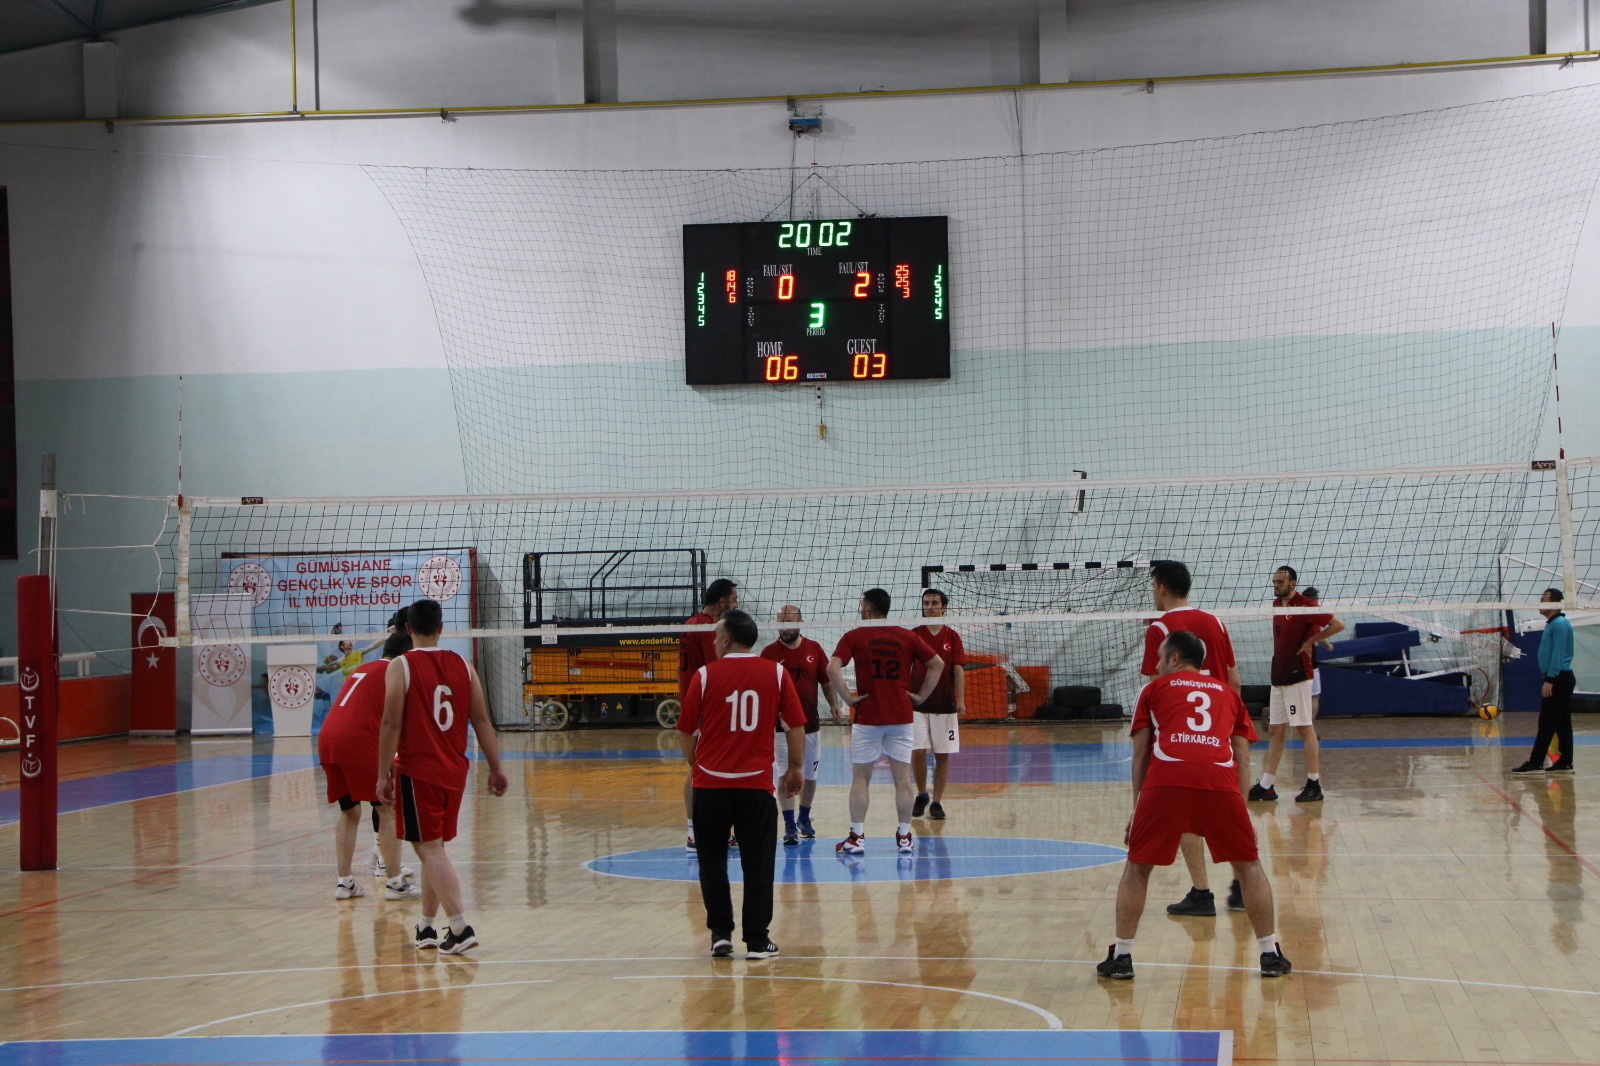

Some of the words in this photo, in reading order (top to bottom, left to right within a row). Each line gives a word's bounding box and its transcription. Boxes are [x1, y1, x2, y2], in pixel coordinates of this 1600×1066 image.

[778, 223, 811, 248] 20
[818, 221, 852, 247] 02
[807, 247, 822, 256] TIME
[763, 264, 793, 277] FAUL/SET
[838, 262, 869, 274] FAUL/SET
[895, 264, 909, 276] 25
[778, 275, 794, 300] 0
[854, 273, 870, 297] 2
[895, 276, 909, 287] 25
[728, 292, 736, 303] 6
[902, 287, 910, 298] 3
[809, 302, 825, 328] 3
[806, 327, 826, 336] PERIOD
[757, 341, 784, 357] HOME
[846, 338, 877, 354] GUEST
[766, 356, 798, 380] 06
[853, 353, 886, 378] 03
[296, 558, 393, 576] GÜMÜŞHANE
[277, 576, 343, 592] GENÇLİK
[347, 577, 366, 589] VE
[371, 575, 412, 588] SPOR
[288, 594, 301, 608] İL
[305, 590, 401, 608] MÜDÜRLÜĞÜ
[619, 636, 681, 646] www.onderlift.c
[871, 658, 900, 680] 12
[339, 672, 367, 707] 7
[1170, 678, 1223, 692] GÜMÜŞHANE
[432, 684, 454, 732] 6
[725, 689, 760, 732] 10
[1186, 691, 1212, 732] 3
[1289, 705, 1296, 715] 9
[948, 730, 955, 741] 2
